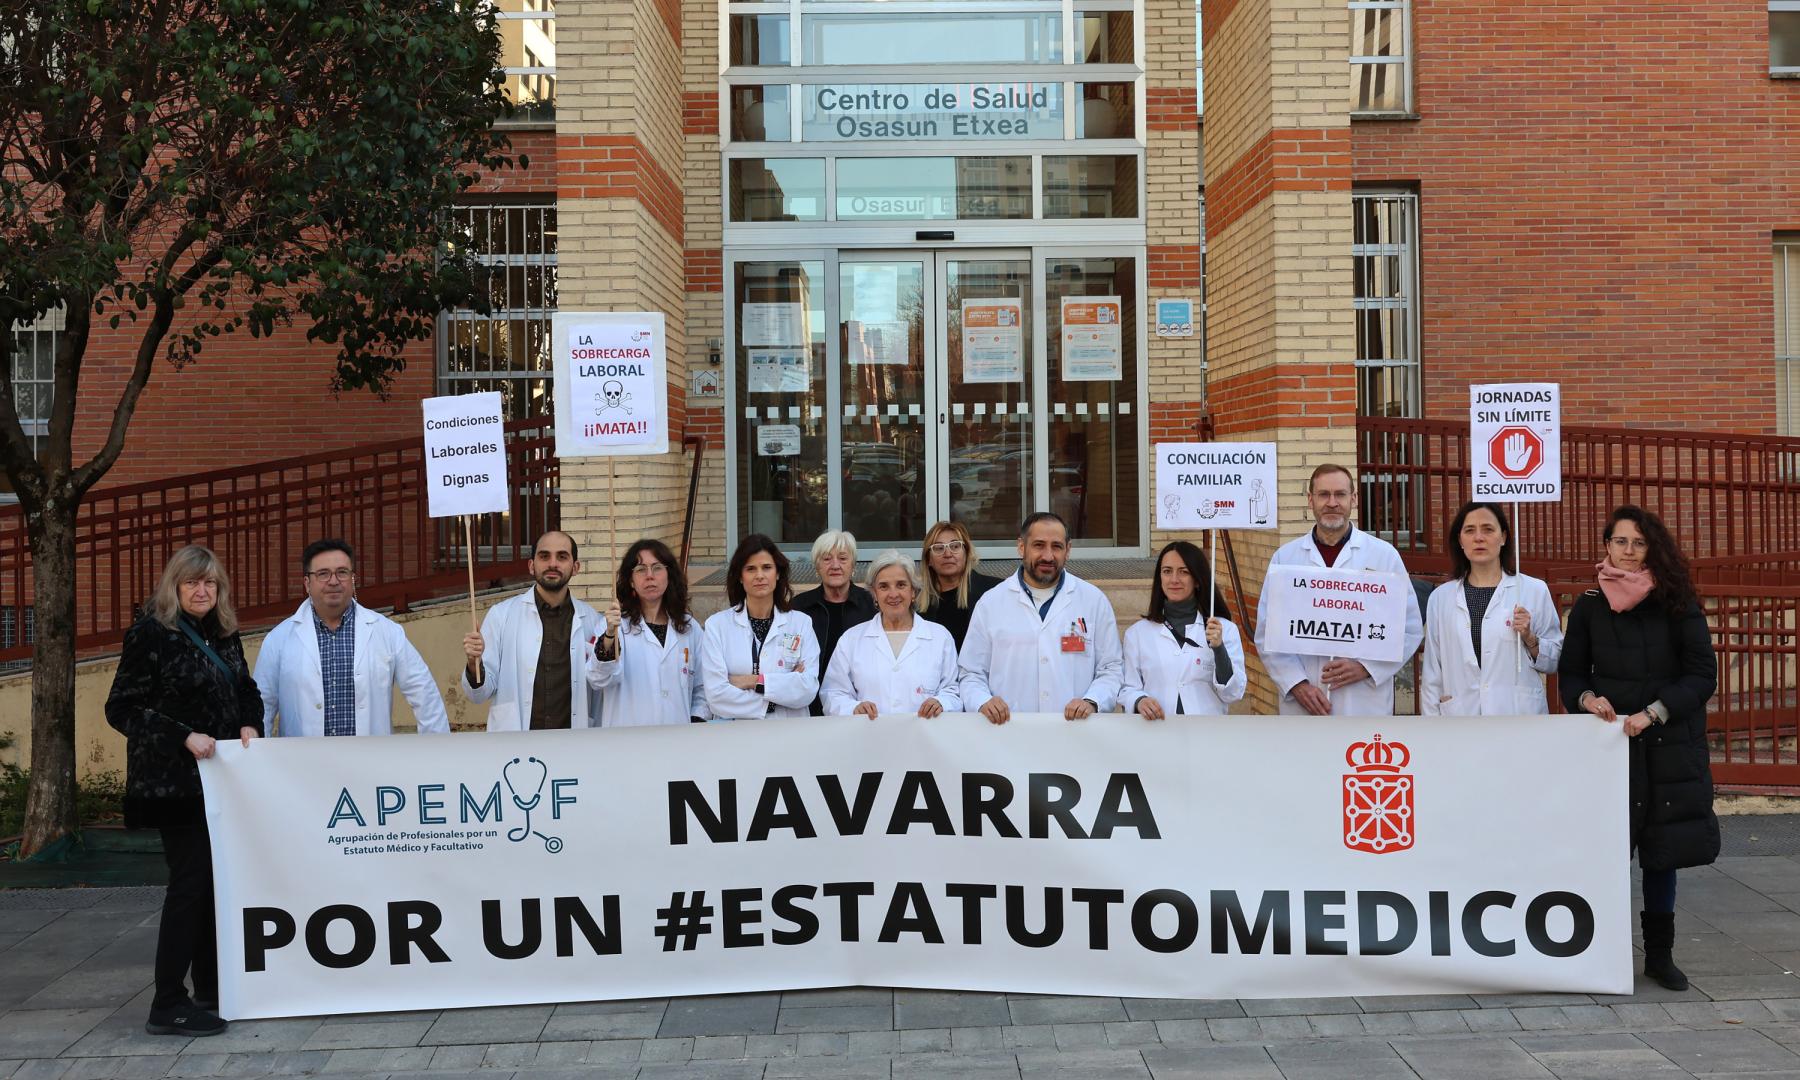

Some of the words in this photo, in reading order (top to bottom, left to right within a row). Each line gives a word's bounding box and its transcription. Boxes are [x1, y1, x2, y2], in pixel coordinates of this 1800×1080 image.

[818, 88, 909, 111] Centro
[924, 88, 957, 110] de
[970, 87, 1048, 109] Salud
[836, 115, 937, 138] Osasun
[952, 114, 1029, 136] Etxea
[579, 335, 593, 345] LA
[571, 348, 651, 360] SOBRECARGA
[580, 364, 645, 377] LABORAL
[1476, 391, 1552, 404] JORNADAS
[426, 415, 499, 430] Condiciones
[1477, 411, 1500, 423] SIN
[1505, 408, 1551, 422] LÍMITE
[584, 421, 647, 437] ¡¡MATA!!
[431, 442, 498, 458] Laborales
[1167, 450, 1266, 465] CONCILIACIÓN
[443, 473, 490, 488] Dignas
[1177, 474, 1242, 485] FAMILIAR
[1476, 483, 1555, 495] ESCLAVITUD
[1214, 500, 1235, 508] SMN
[1293, 578, 1307, 588] LA
[1310, 579, 1387, 594] SOBRECARGA
[1313, 598, 1365, 611] LABORAL
[1289, 619, 1362, 640] ¡MATA!
[668, 771, 1162, 846] NAVARRA
[327, 832, 385, 845] Agrupación
[386, 831, 399, 840] de
[400, 830, 465, 840] Profesionales
[466, 831, 482, 840] por
[485, 829, 498, 837] un
[343, 846, 384, 855] Estatuto
[386, 843, 421, 853] Médico
[423, 845, 429, 853] y
[431, 842, 484, 852] Facultativo
[243, 899, 452, 973] POR
[481, 894, 623, 960] UN
[654, 881, 1595, 958] #ESTATUTOMEDICO
